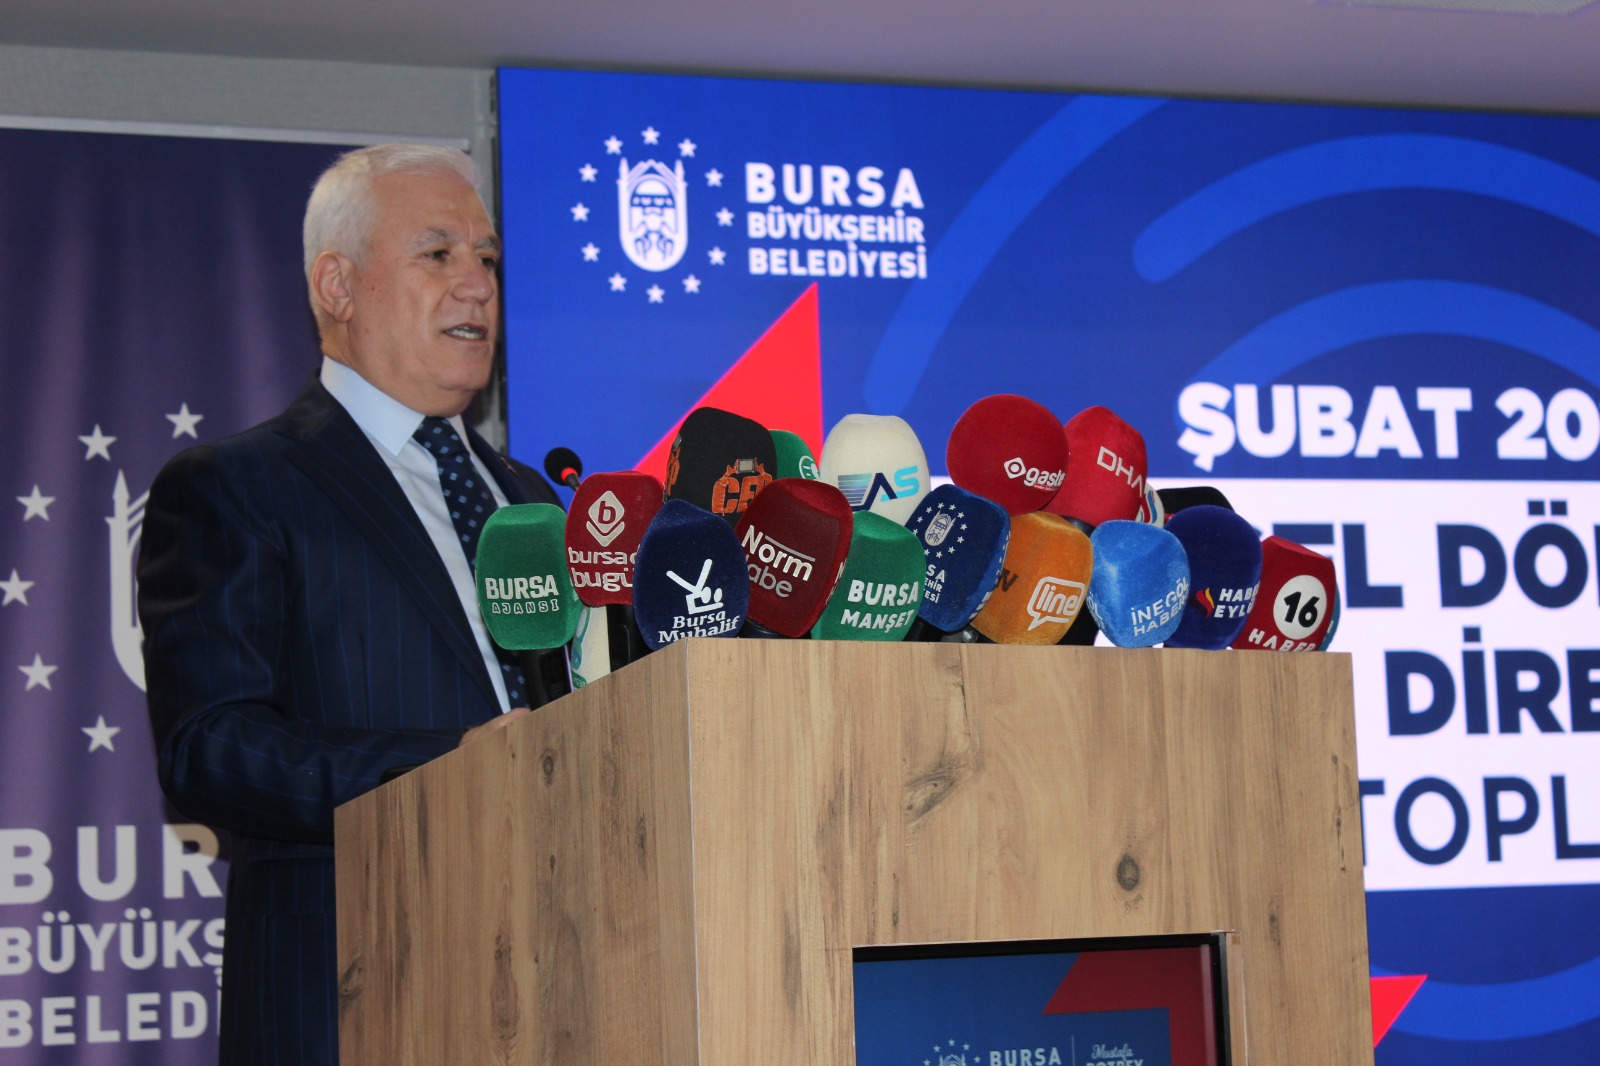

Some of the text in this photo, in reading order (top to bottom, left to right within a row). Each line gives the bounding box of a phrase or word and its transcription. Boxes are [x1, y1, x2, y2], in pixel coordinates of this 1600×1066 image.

[746, 163, 924, 208] BURSA
[748, 242, 927, 279] BELEDİYESİ
[1177, 382, 1600, 472] ŞUBAT 20
[1097, 446, 1143, 498] DHA
[741, 524, 813, 581] Norm
[1436, 499, 1600, 609] DÖ
[485, 575, 560, 600] BURSA
[745, 554, 793, 598] abe
[848, 579, 919, 606] BURSA
[491, 599, 560, 615] AJANSI
[672, 611, 726, 629] Bursa
[1036, 584, 1079, 616] line
[1283, 591, 1320, 628] 16
[840, 609, 914, 633] MANŞET
[1384, 626, 1600, 737] DİRE
[0, 823, 223, 905] BUR
[0, 988, 222, 1048] BELED
[989, 1047, 1062, 1066] BURSA
